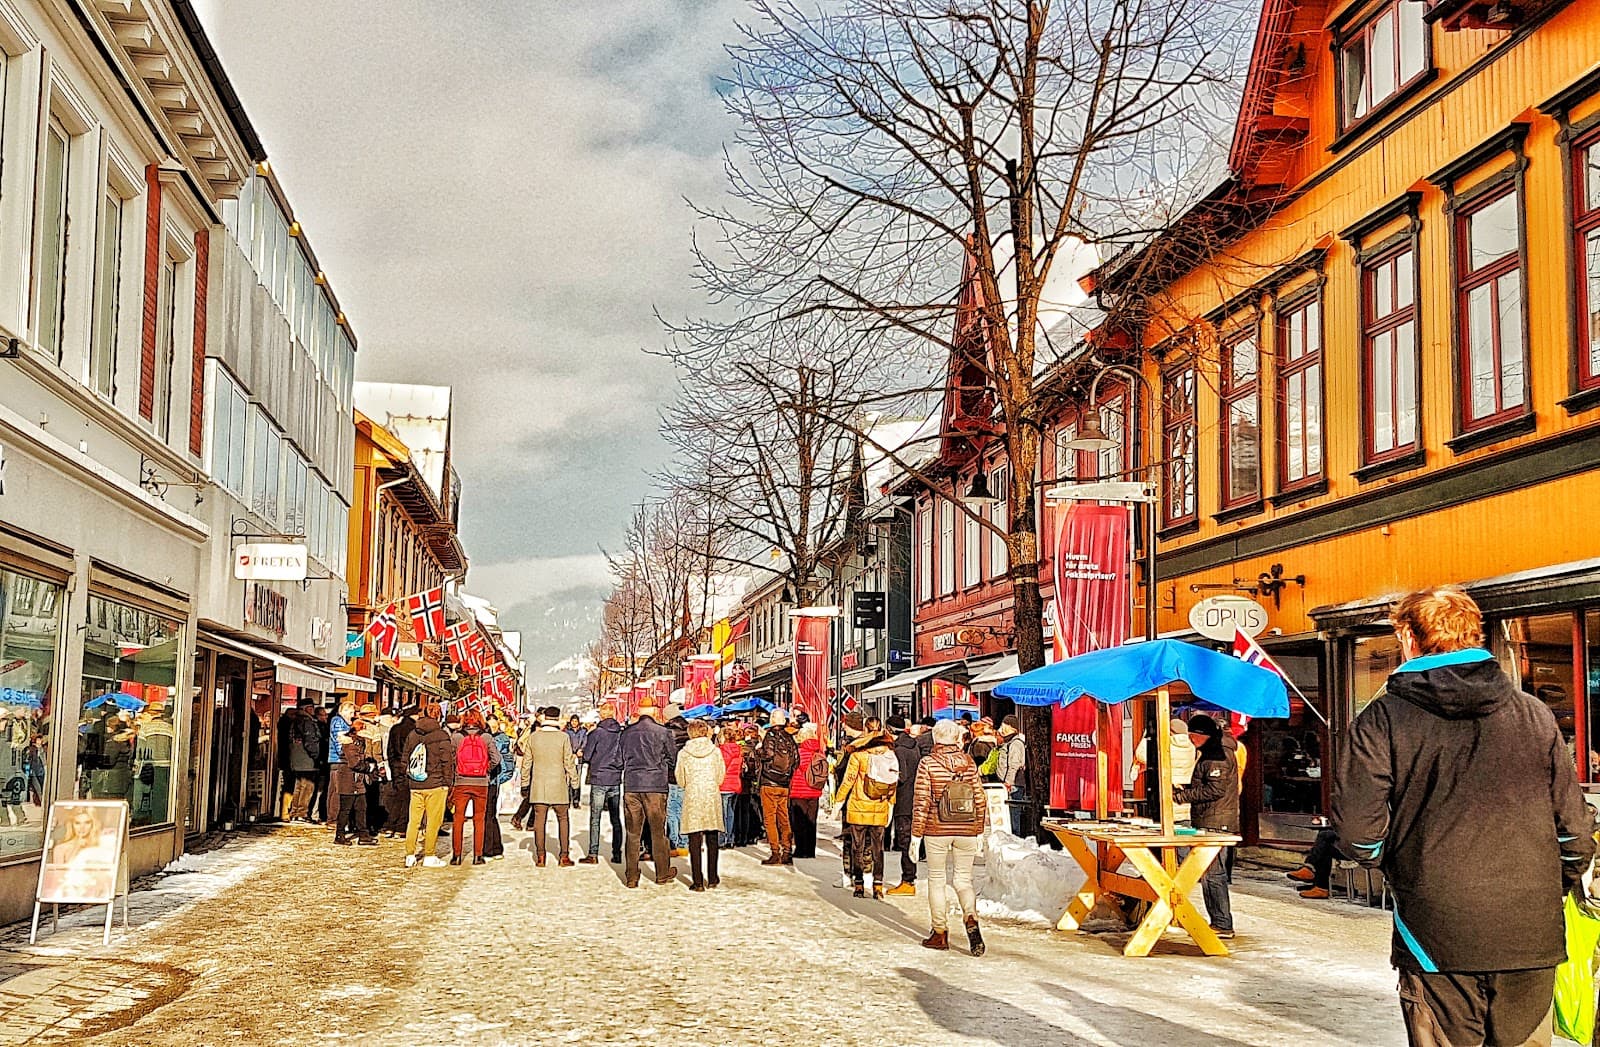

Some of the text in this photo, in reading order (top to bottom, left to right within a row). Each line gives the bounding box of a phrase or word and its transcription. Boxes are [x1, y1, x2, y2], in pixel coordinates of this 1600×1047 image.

[253, 556, 302, 568] FRETEX
[1206, 608, 1260, 628] OPUS
[1056, 733, 1091, 743] FAKKEL
